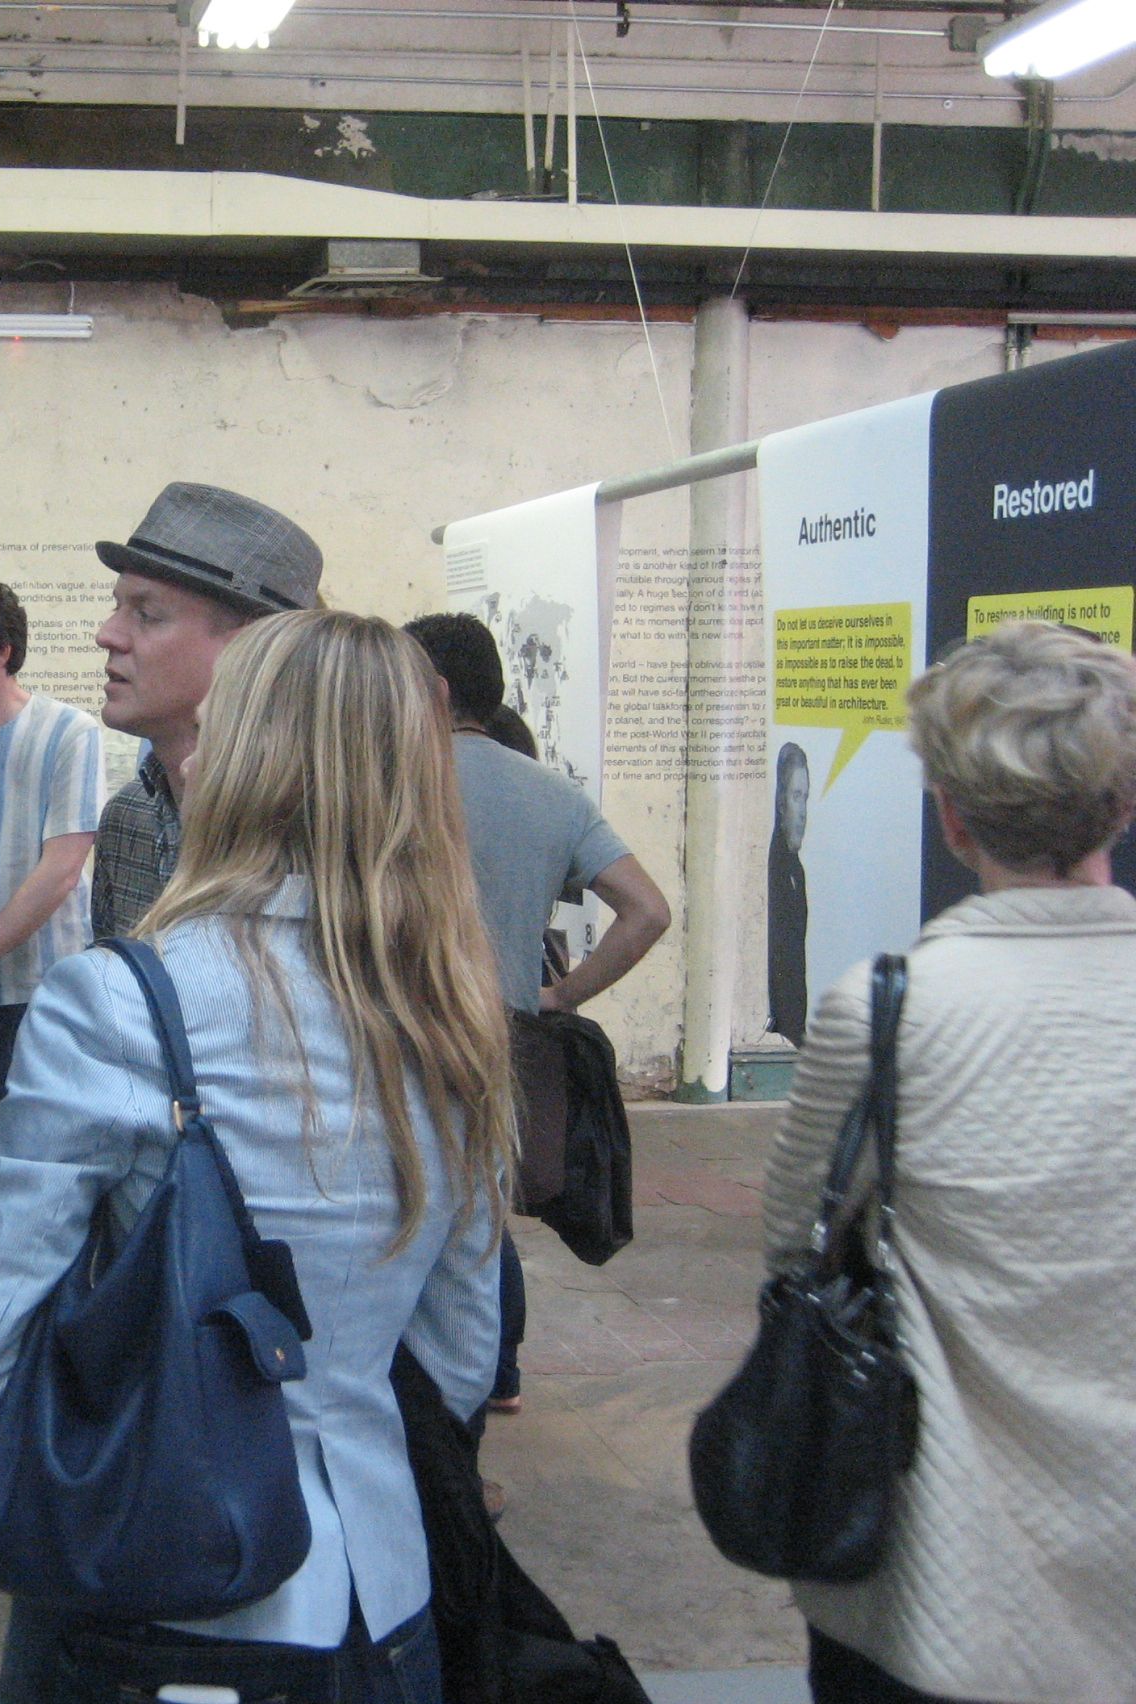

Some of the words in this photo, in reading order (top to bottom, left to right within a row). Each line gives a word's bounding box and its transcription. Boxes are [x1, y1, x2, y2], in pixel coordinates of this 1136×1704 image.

[993, 469, 1094, 520] Restored
[798, 507, 876, 546] Authentic
[30, 542, 39, 551] of
[42, 543, 95, 553] preservatio
[80, 594, 94, 602] the
[974, 609, 985, 624] To
[1027, 604, 1064, 624] building
[1067, 604, 1077, 620] is
[1080, 603, 1097, 619] not
[1101, 603, 1110, 618] to
[777, 619, 786, 631] Do
[787, 619, 798, 630] not
[809, 620, 816, 629] us
[818, 616, 843, 629] deceive
[845, 614, 884, 628] ourselves
[886, 613, 892, 627] in
[790, 637, 820, 652] important
[847, 635, 853, 648] it
[855, 636, 863, 648] is
[612, 660, 636, 668] world
[785, 657, 818, 671] impossible
[829, 656, 836, 669] to
[838, 657, 858, 668] raise
[861, 656, 873, 668] the
[896, 656, 903, 669] to
[53, 685, 95, 693] preserve
[776, 677, 797, 688] restore
[799, 676, 825, 691] anything
[827, 676, 841, 688] that
[844, 676, 858, 688] has
[861, 678, 878, 689] ever
[880, 676, 897, 689] been
[776, 696, 791, 709] great
[792, 698, 799, 708] or
[801, 696, 828, 708] beautiful
[830, 696, 836, 708] in
[838, 697, 888, 710] architecture.
[606, 744, 646, 752] elements
[585, 924, 592, 944] 8
